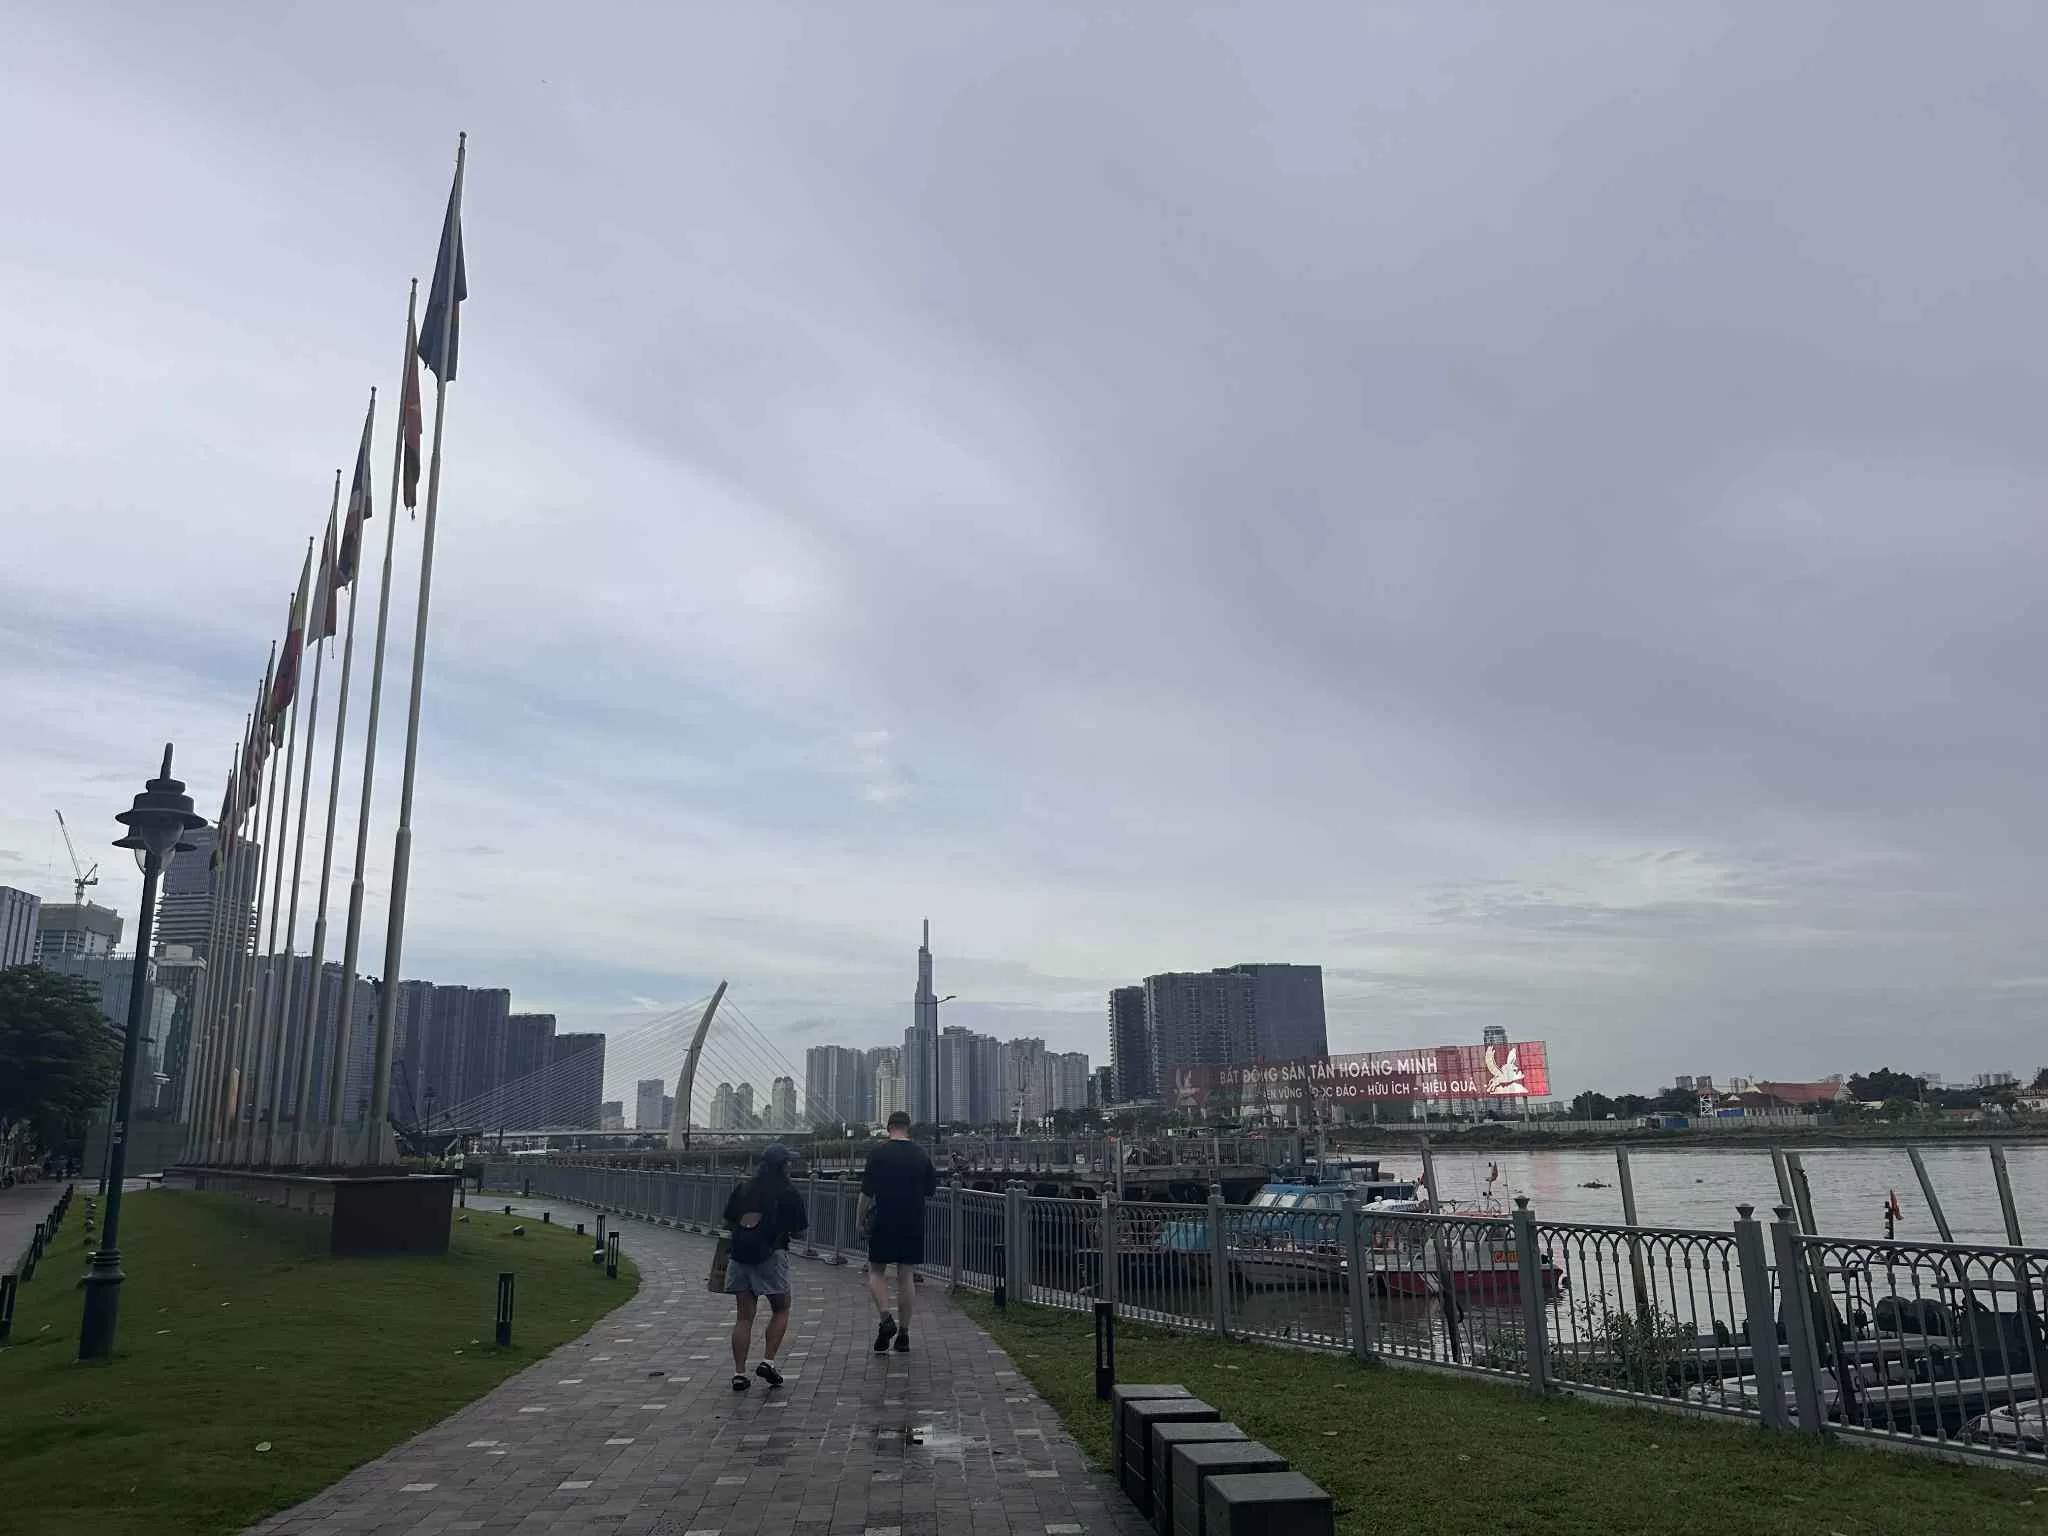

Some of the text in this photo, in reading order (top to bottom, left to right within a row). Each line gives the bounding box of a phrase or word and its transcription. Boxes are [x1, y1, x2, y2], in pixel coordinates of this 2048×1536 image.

[1281, 1060, 1306, 1081] SẢN
[1309, 1060, 1335, 1080] TÂN
[1340, 1058, 1393, 1078] HOÀNG
[1397, 1057, 1438, 1075] MINH
[1391, 1080, 1410, 1095] ÍCH
[1422, 1079, 1447, 1096] HIỆU
[1450, 1076, 1478, 1092] QUẢ
